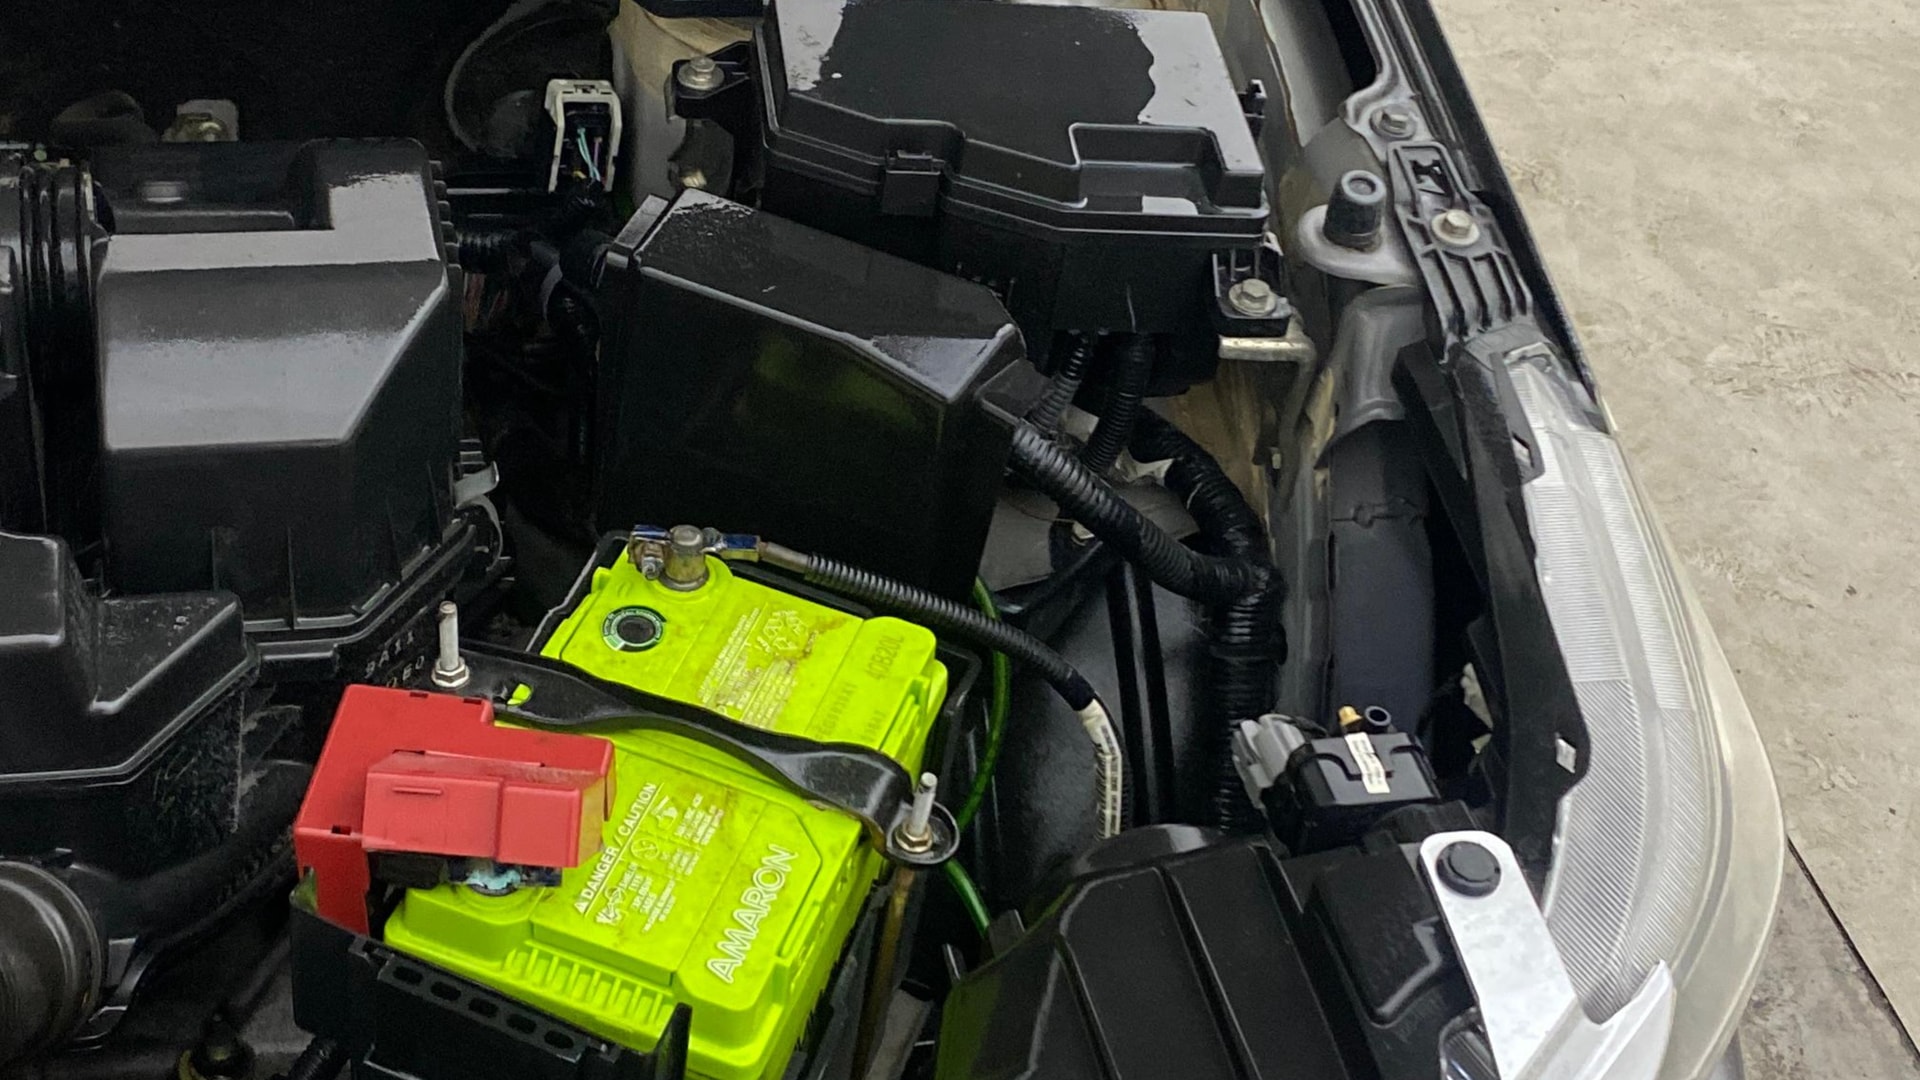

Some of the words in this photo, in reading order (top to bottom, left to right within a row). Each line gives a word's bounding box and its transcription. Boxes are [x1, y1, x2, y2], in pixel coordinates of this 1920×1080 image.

[580, 846, 620, 903] DANGER
[618, 782, 657, 836] CAUTION
[706, 843, 798, 983] AMARON
